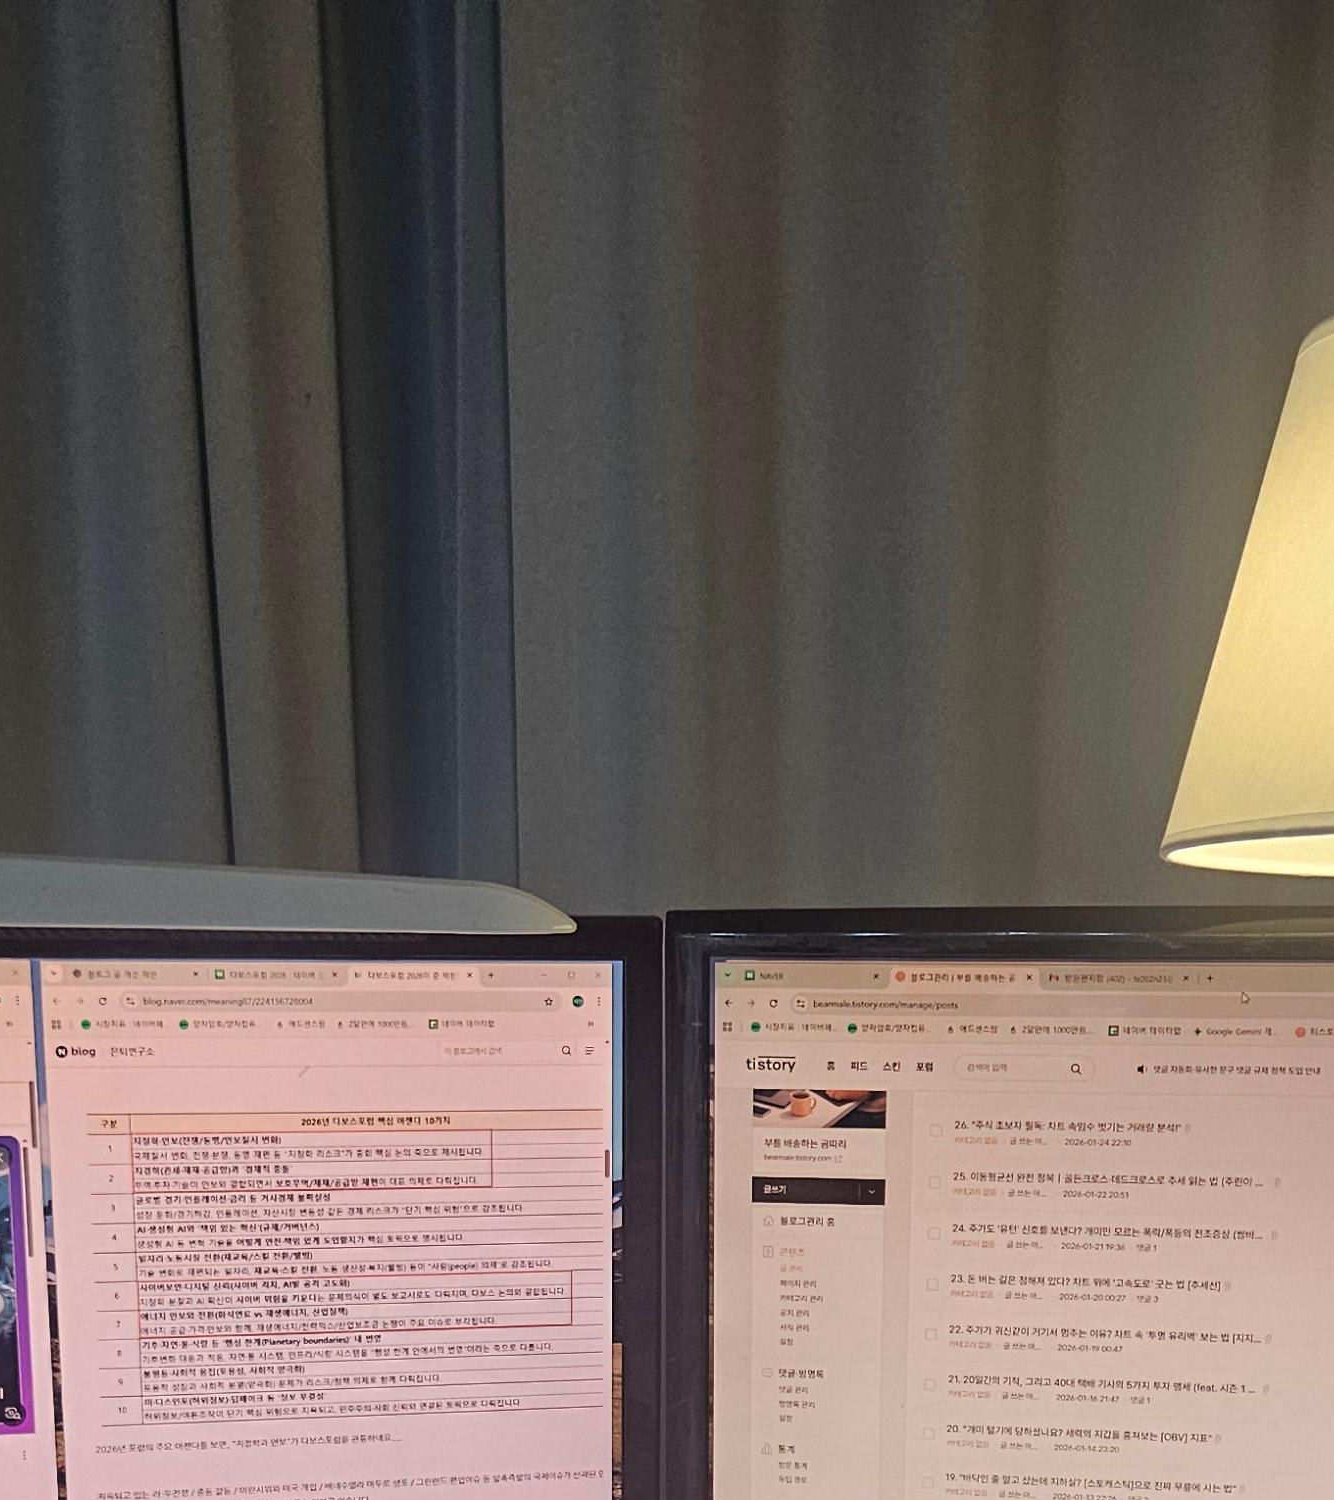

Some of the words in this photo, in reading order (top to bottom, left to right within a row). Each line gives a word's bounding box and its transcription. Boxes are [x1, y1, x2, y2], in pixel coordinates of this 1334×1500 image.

[813, 1000, 958, 1010] bearmale.tistory.com/manage/posts
[71, 1048, 95, 1058] blog
[747, 1056, 795, 1073] tistory
[851, 1061, 868, 1071] 피드
[883, 1061, 900, 1072] 스킨
[916, 1061, 933, 1072] 포럼
[101, 1120, 117, 1129] 구분
[301, 1117, 330, 1127] 2026년
[954, 1121, 969, 1130] 26.
[1048, 1121, 1065, 1131] 차트
[1068, 1122, 1094, 1132] 속임수
[763, 1185, 787, 1195] 글쓰기
[950, 1274, 964, 1284] 23.
[1073, 1277, 1090, 1287] 차트
[1160, 1432, 1187, 1443] [OBV]
